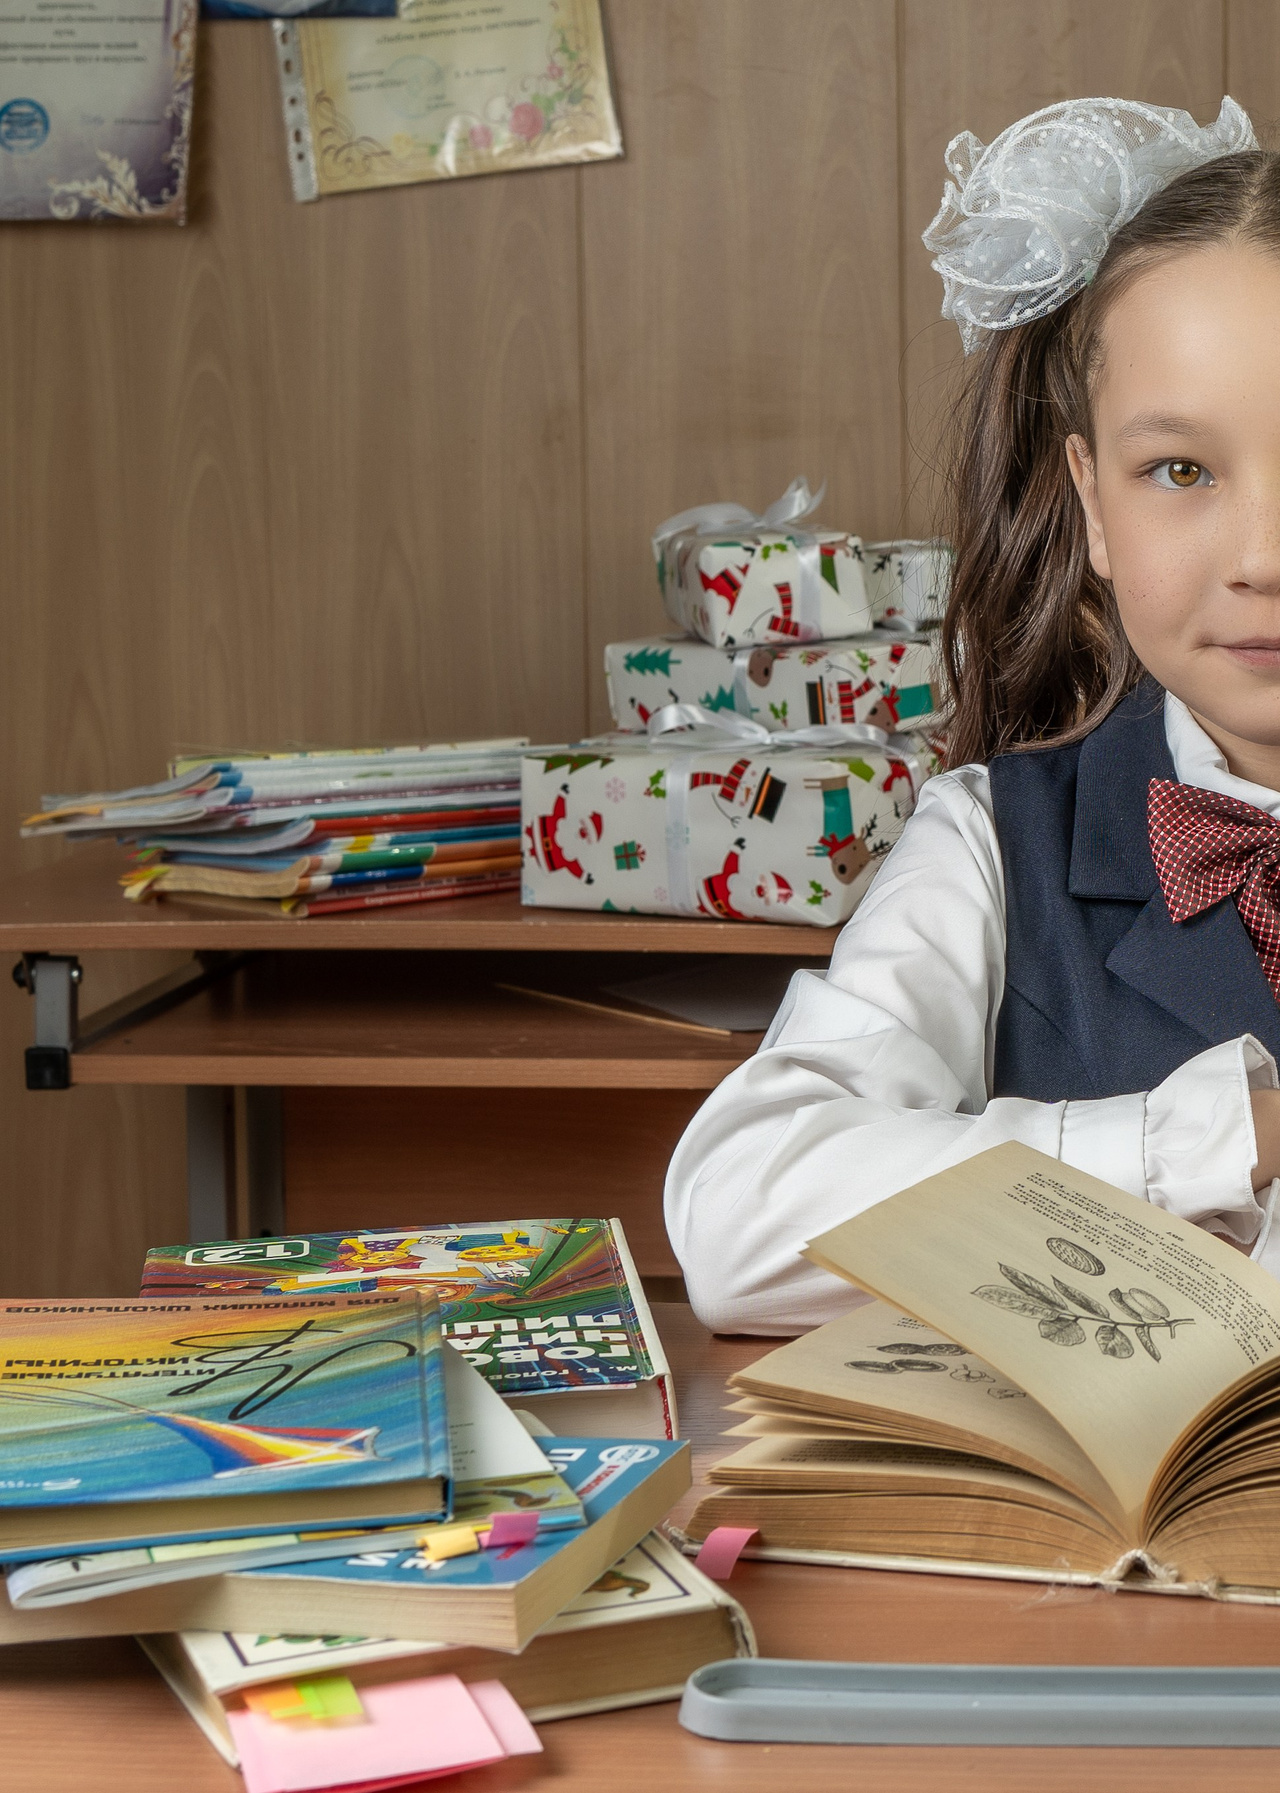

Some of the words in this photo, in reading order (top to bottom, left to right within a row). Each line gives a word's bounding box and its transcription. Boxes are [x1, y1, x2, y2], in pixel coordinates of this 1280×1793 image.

[1012, 1185, 1046, 1205] очень
[1028, 1188, 1061, 1207] жира
[1030, 1174, 1120, 1221] действительно
[1053, 1189, 1111, 1223] подумать,
[1072, 1190, 1108, 1211] ореха.
[1031, 1206, 1080, 1234] мнению
[1047, 1204, 1083, 1224] орехи
[1112, 1211, 1165, 1241] грецкого
[1072, 1221, 1101, 1239] плод
[1083, 1223, 1132, 1251] грецкие
[1114, 1223, 1155, 1247] можно
[201, 1242, 290, 1262] 1-2
[1107, 1246, 1151, 1273] вишни.
[1155, 1239, 1201, 1268] Греция.
[1170, 1242, 1216, 1270] деревья
[1146, 1262, 1173, 1280] орех
[1152, 1259, 1185, 1282] было,
[1152, 1254, 1223, 1302] питательны.
[1161, 1247, 1219, 1286] названию,
[1155, 1273, 1218, 1320] переспелой
[1201, 1277, 1235, 1306] белка.
[1219, 1272, 1253, 1298] дикие
[5, 1304, 191, 1314] ШКОЛЬНИКОВ
[203, 1300, 336, 1313] МЛАДШИХ
[347, 1297, 399, 1307] ДЛЯ
[1176, 1281, 1236, 1330] настоящий
[1226, 1283, 1264, 1318] родина
[441, 1314, 622, 1336] ПИШ
[1240, 1303, 1265, 1329] Судя
[1235, 1312, 1269, 1353] вкусны
[1232, 1333, 1256, 1366] меру,
[1239, 1333, 1260, 1362] ных,
[483, 1368, 571, 1381] ГОЛОВ
[577, 1366, 600, 1374] В.
[609, 1364, 638, 1373] М.
